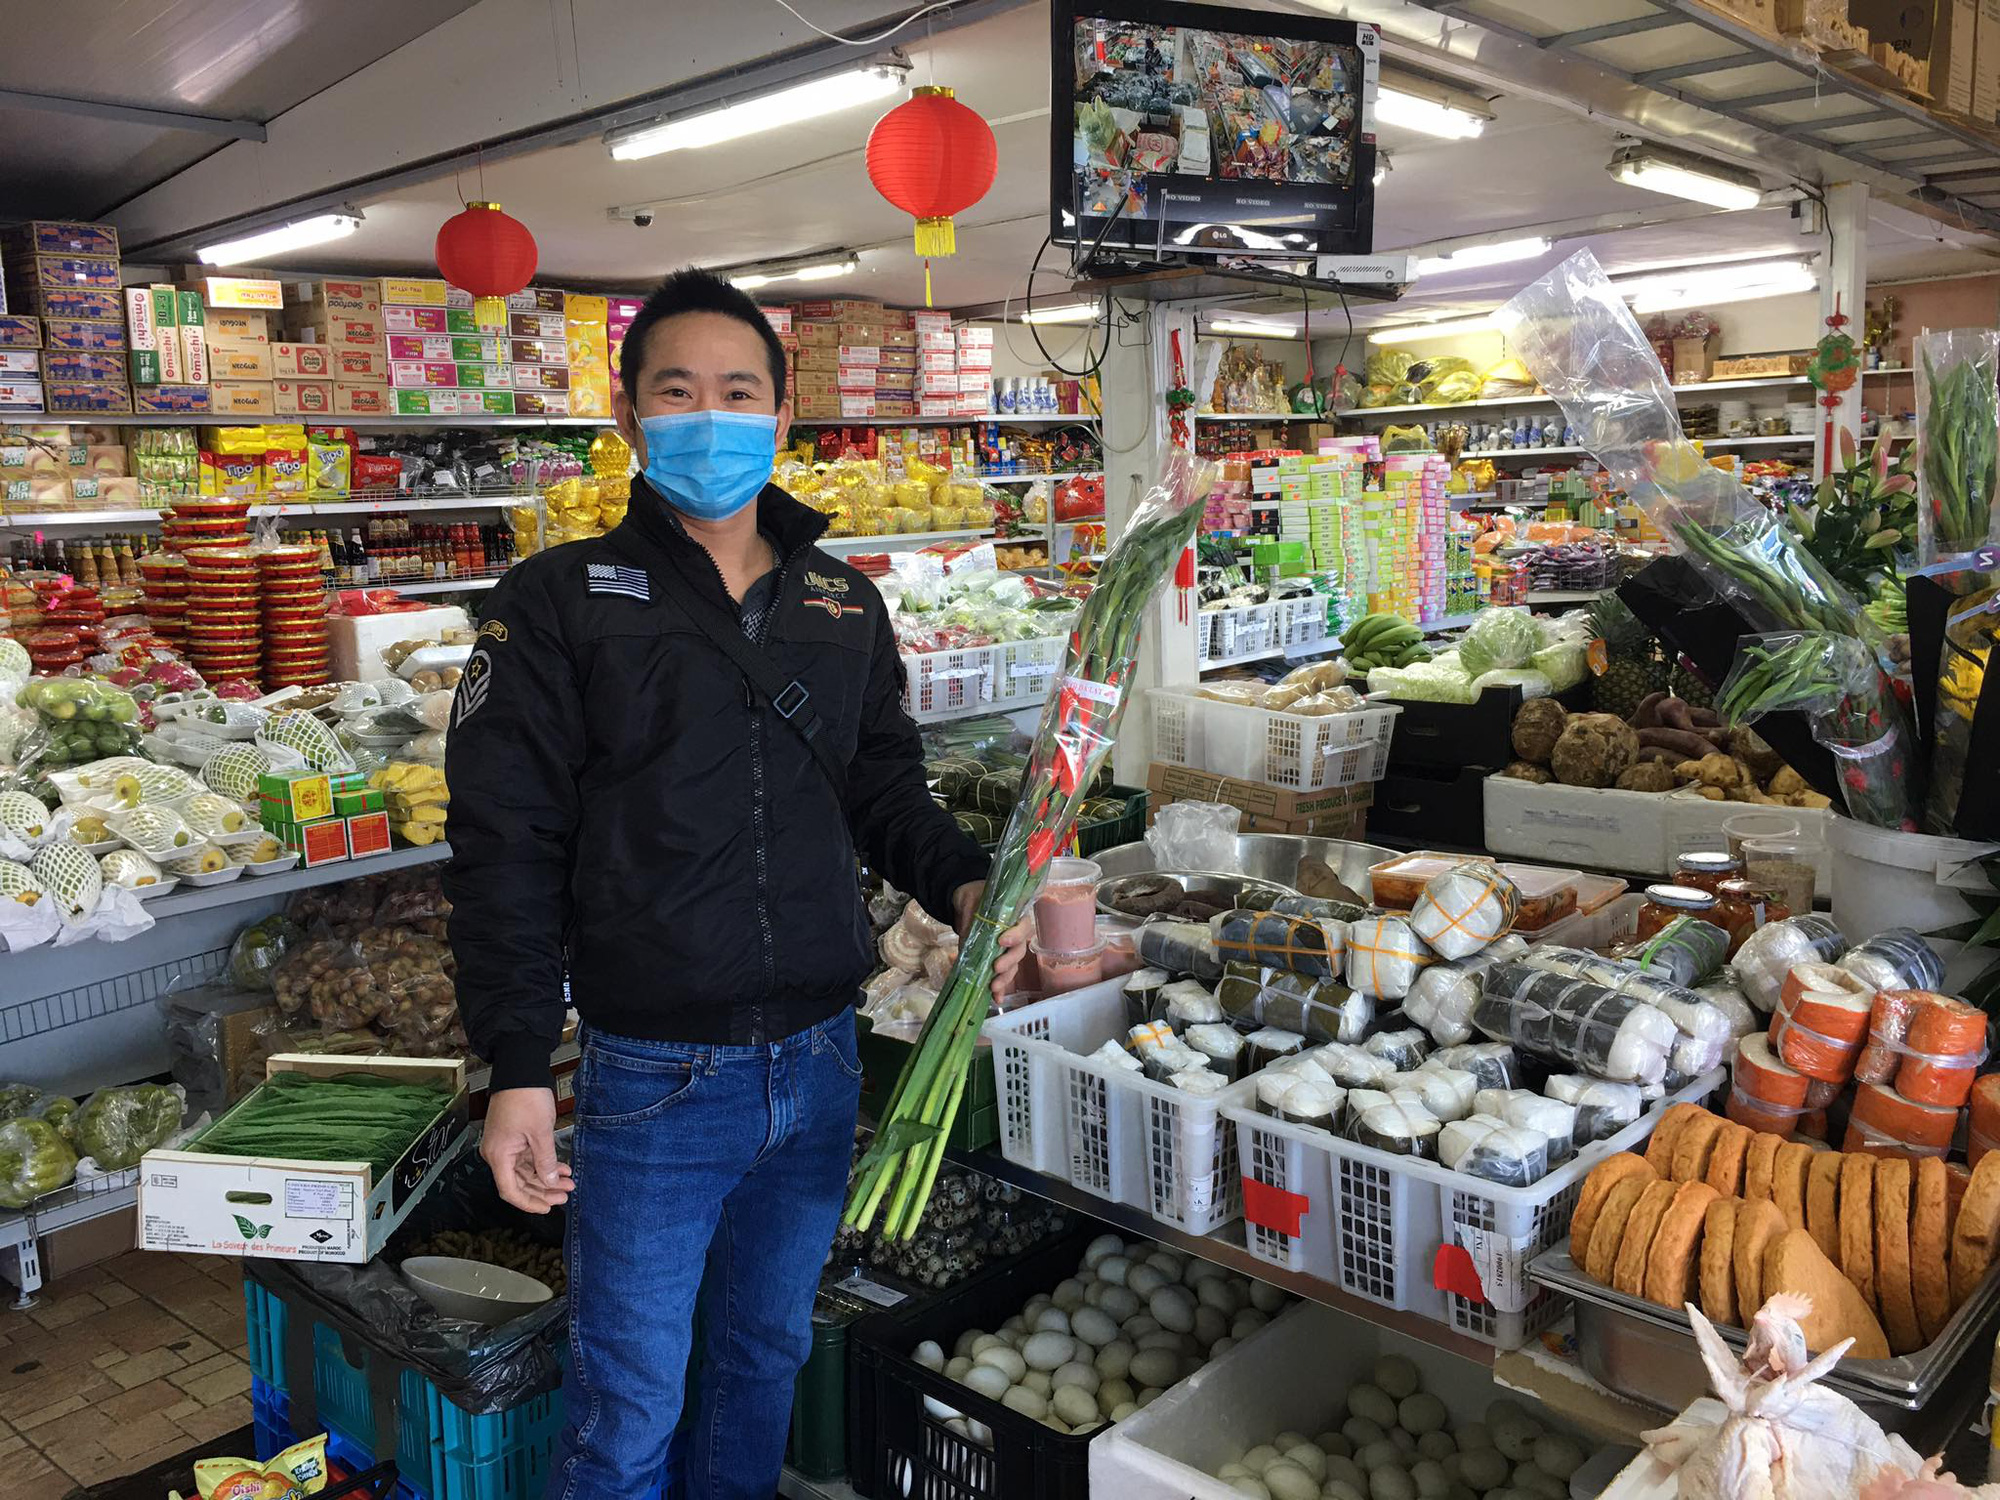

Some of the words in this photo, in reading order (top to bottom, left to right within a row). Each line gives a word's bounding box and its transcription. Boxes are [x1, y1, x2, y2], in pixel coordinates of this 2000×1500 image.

[1362, 33, 1374, 41] HD
[327, 299, 364, 310] Seafood
[134, 293, 148, 341] Omachi
[163, 335, 175, 378] Omachi
[190, 335, 202, 381] Omachi
[318, 448, 344, 465] Tipo
[225, 464, 254, 479] Tipo
[273, 461, 301, 476] Tipo
[251, 1242, 263, 1252] des
[266, 1244, 297, 1254] Primeurs
[231, 1482, 261, 1497] Oishi
